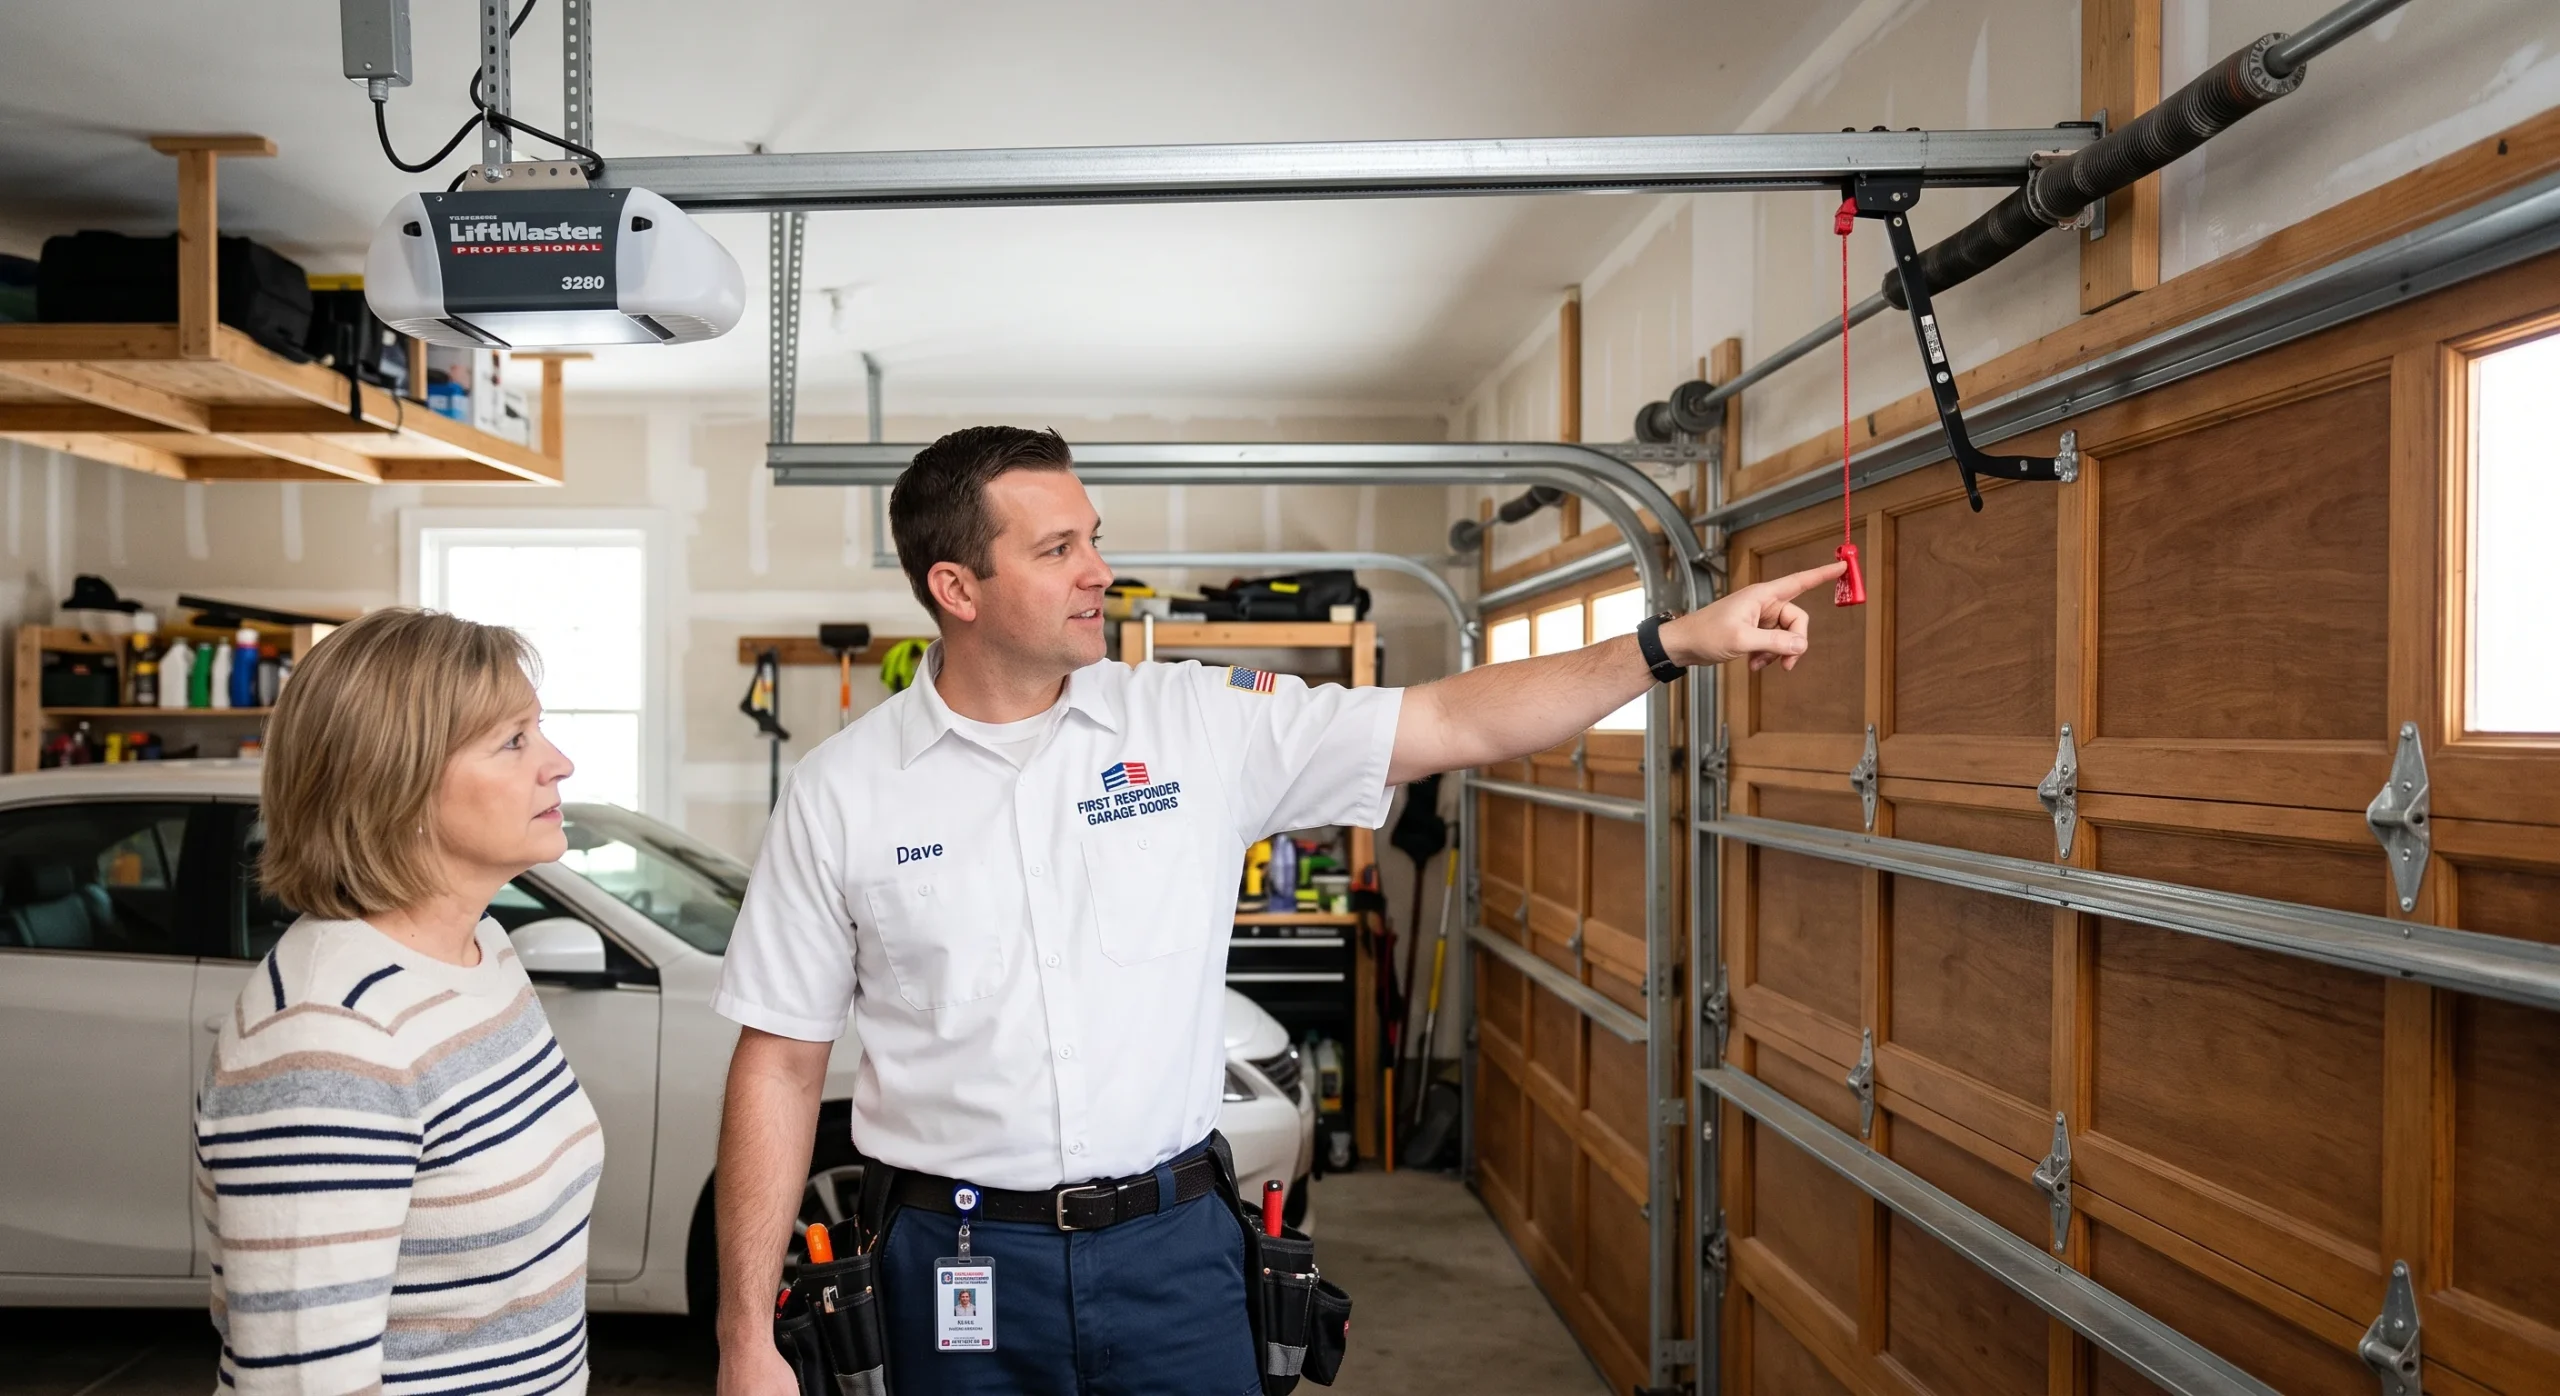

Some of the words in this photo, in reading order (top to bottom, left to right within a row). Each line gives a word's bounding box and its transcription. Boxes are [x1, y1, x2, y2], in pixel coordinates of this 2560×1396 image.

[456, 244, 601, 254] PROFESSIONAL
[561, 275, 605, 290] 3280
[1077, 796, 1111, 814] FIRST
[1114, 781, 1181, 806] RESPONDER
[1087, 805, 1137, 826] GARAGE
[1138, 796, 1179, 815] DOORS
[896, 842, 944, 865] Dave
